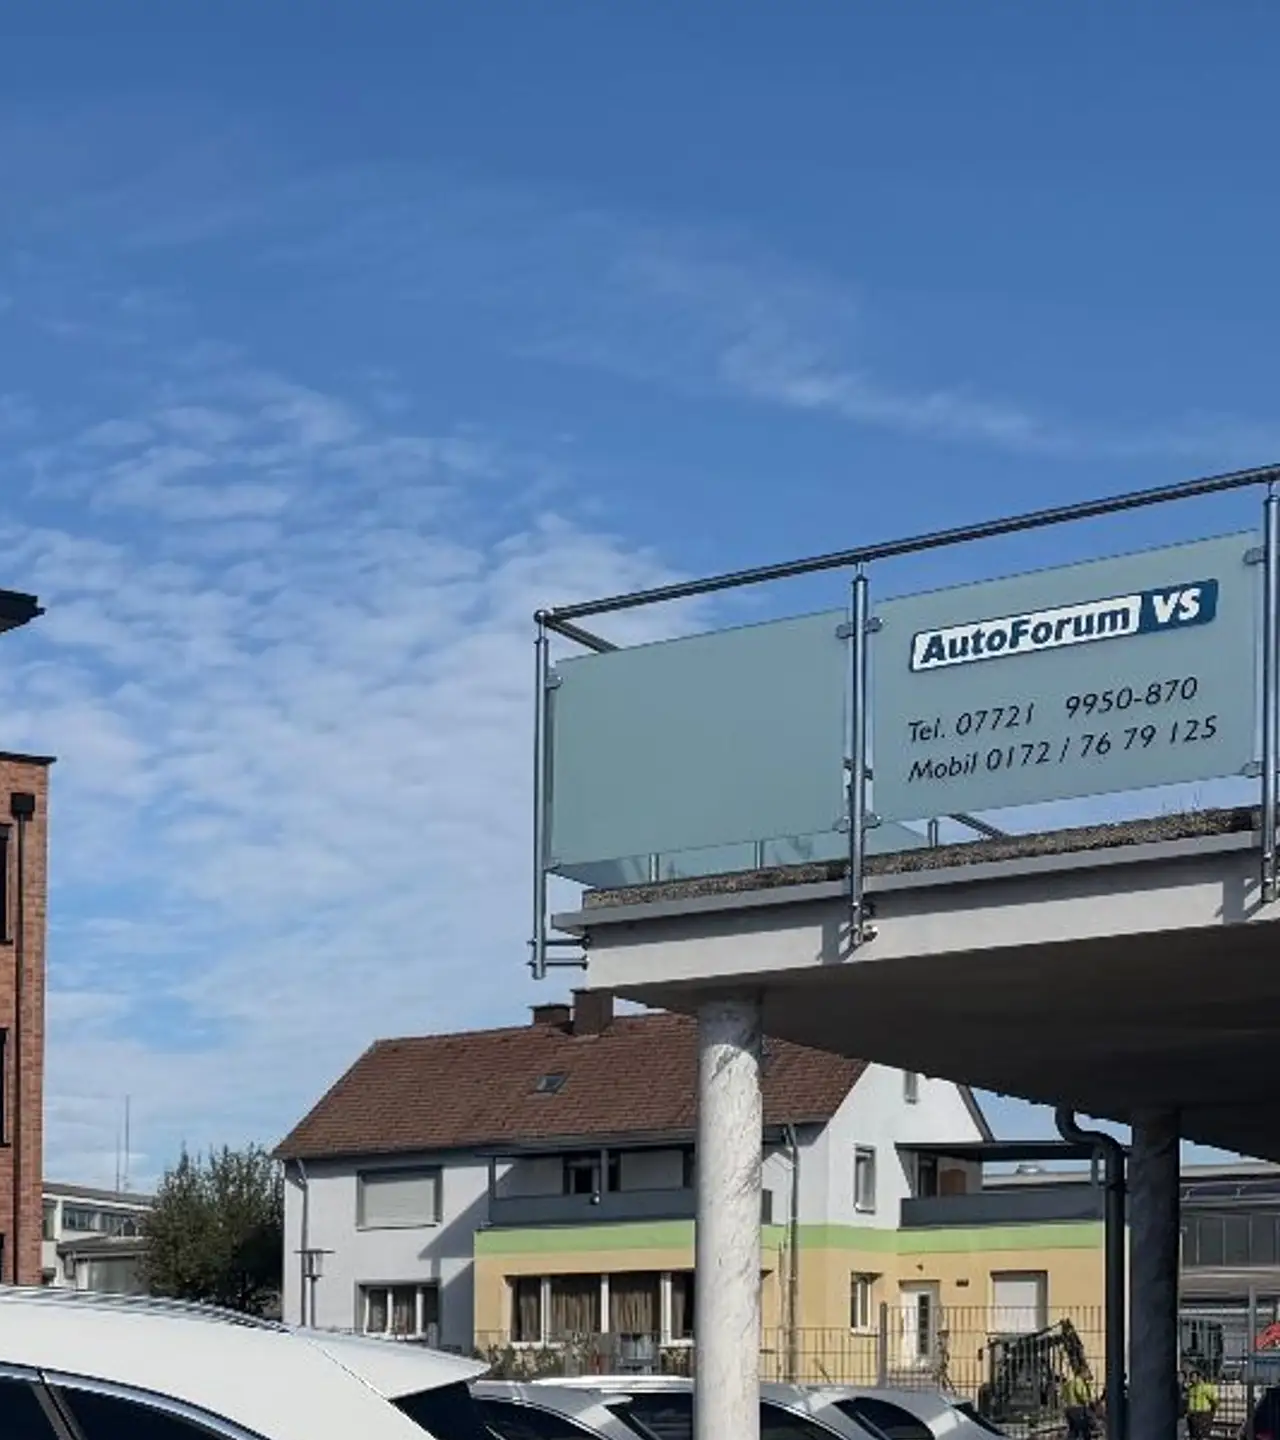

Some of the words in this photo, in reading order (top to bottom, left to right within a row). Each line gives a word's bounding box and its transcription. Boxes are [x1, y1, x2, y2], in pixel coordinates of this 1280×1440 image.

[919, 607, 1131, 664] AutoForum
[1152, 587, 1202, 624] VS
[907, 717, 946, 743] Tel.
[955, 702, 1035, 737] 07721
[1065, 676, 1198, 719] 9950-870
[907, 751, 979, 783] Mobil
[986, 741, 1051, 772] 0172
[1080, 731, 1112, 758] 76
[1123, 724, 1157, 750] 79
[1169, 714, 1218, 745] 125
